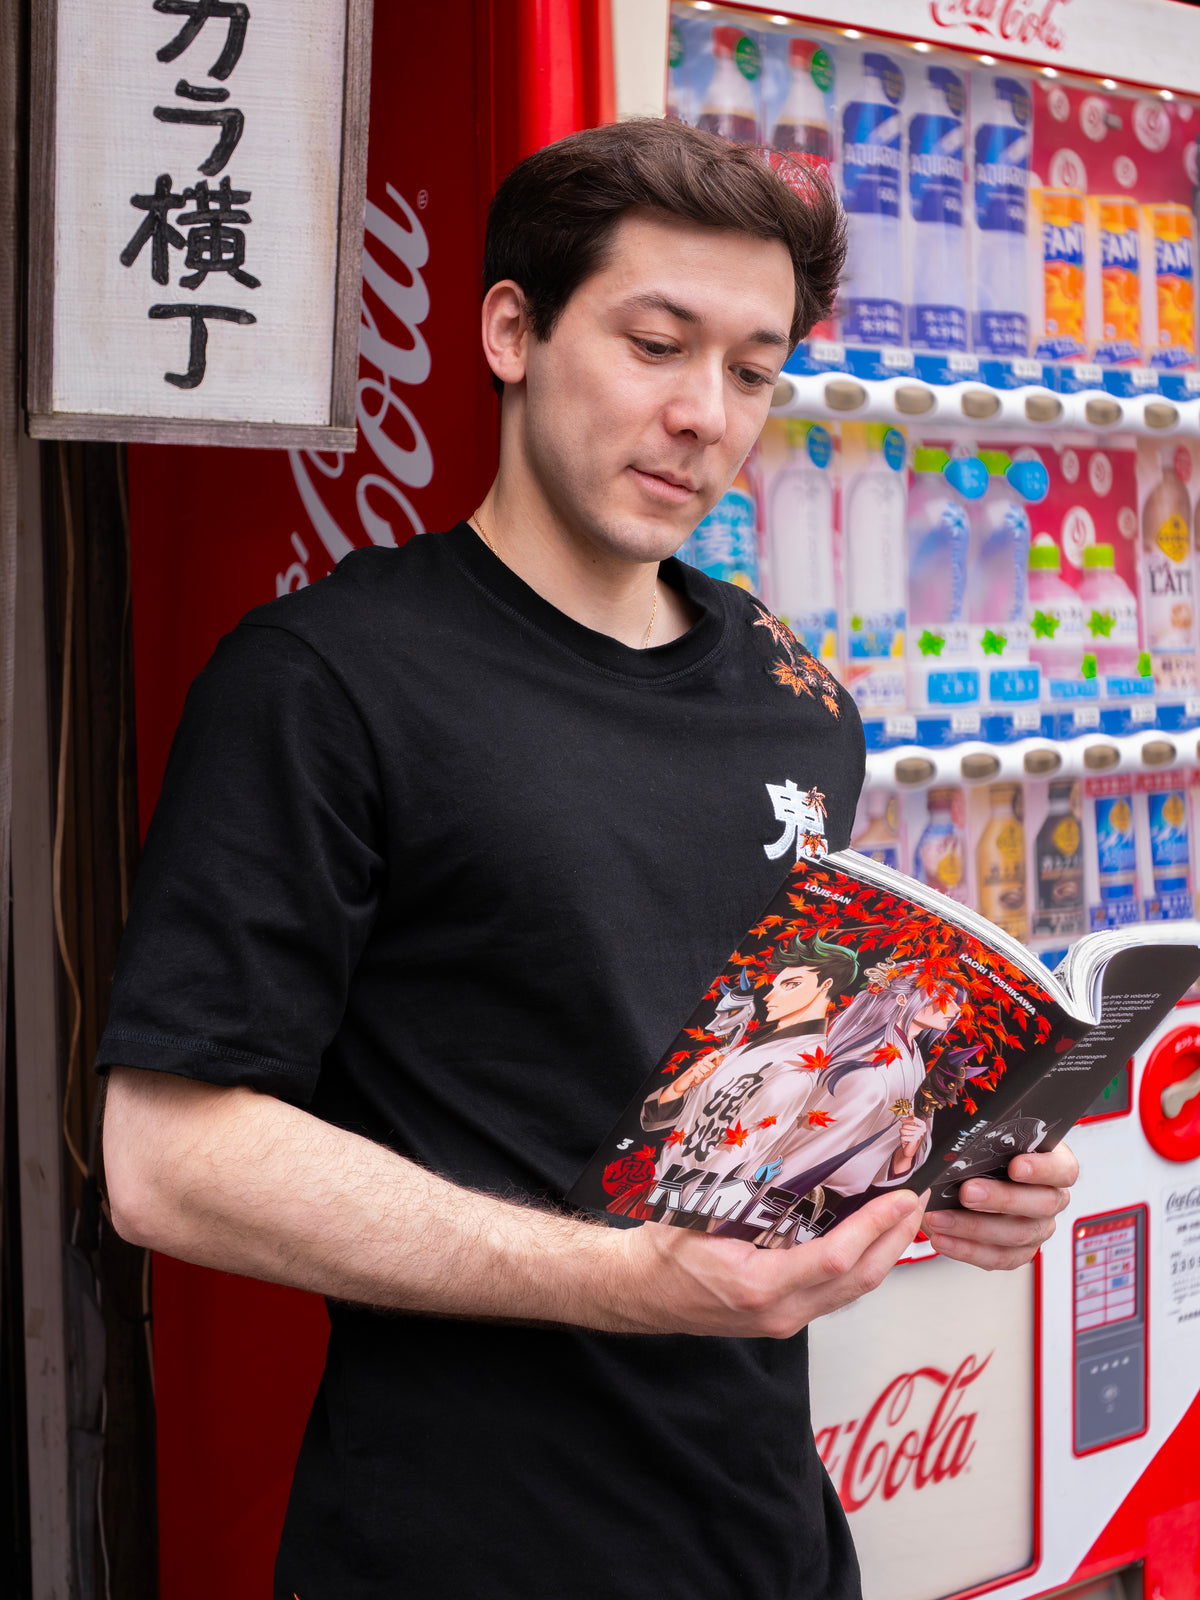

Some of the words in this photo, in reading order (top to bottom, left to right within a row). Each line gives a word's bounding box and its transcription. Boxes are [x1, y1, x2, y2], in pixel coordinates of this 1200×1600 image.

[804, 882, 852, 905] LOUIS-SAN
[959, 953, 988, 975] KAORI
[987, 971, 1036, 1015] YOSHIKAWA
[616, 1138, 634, 1150] 3
[645, 1160, 837, 1245] KIMEN
